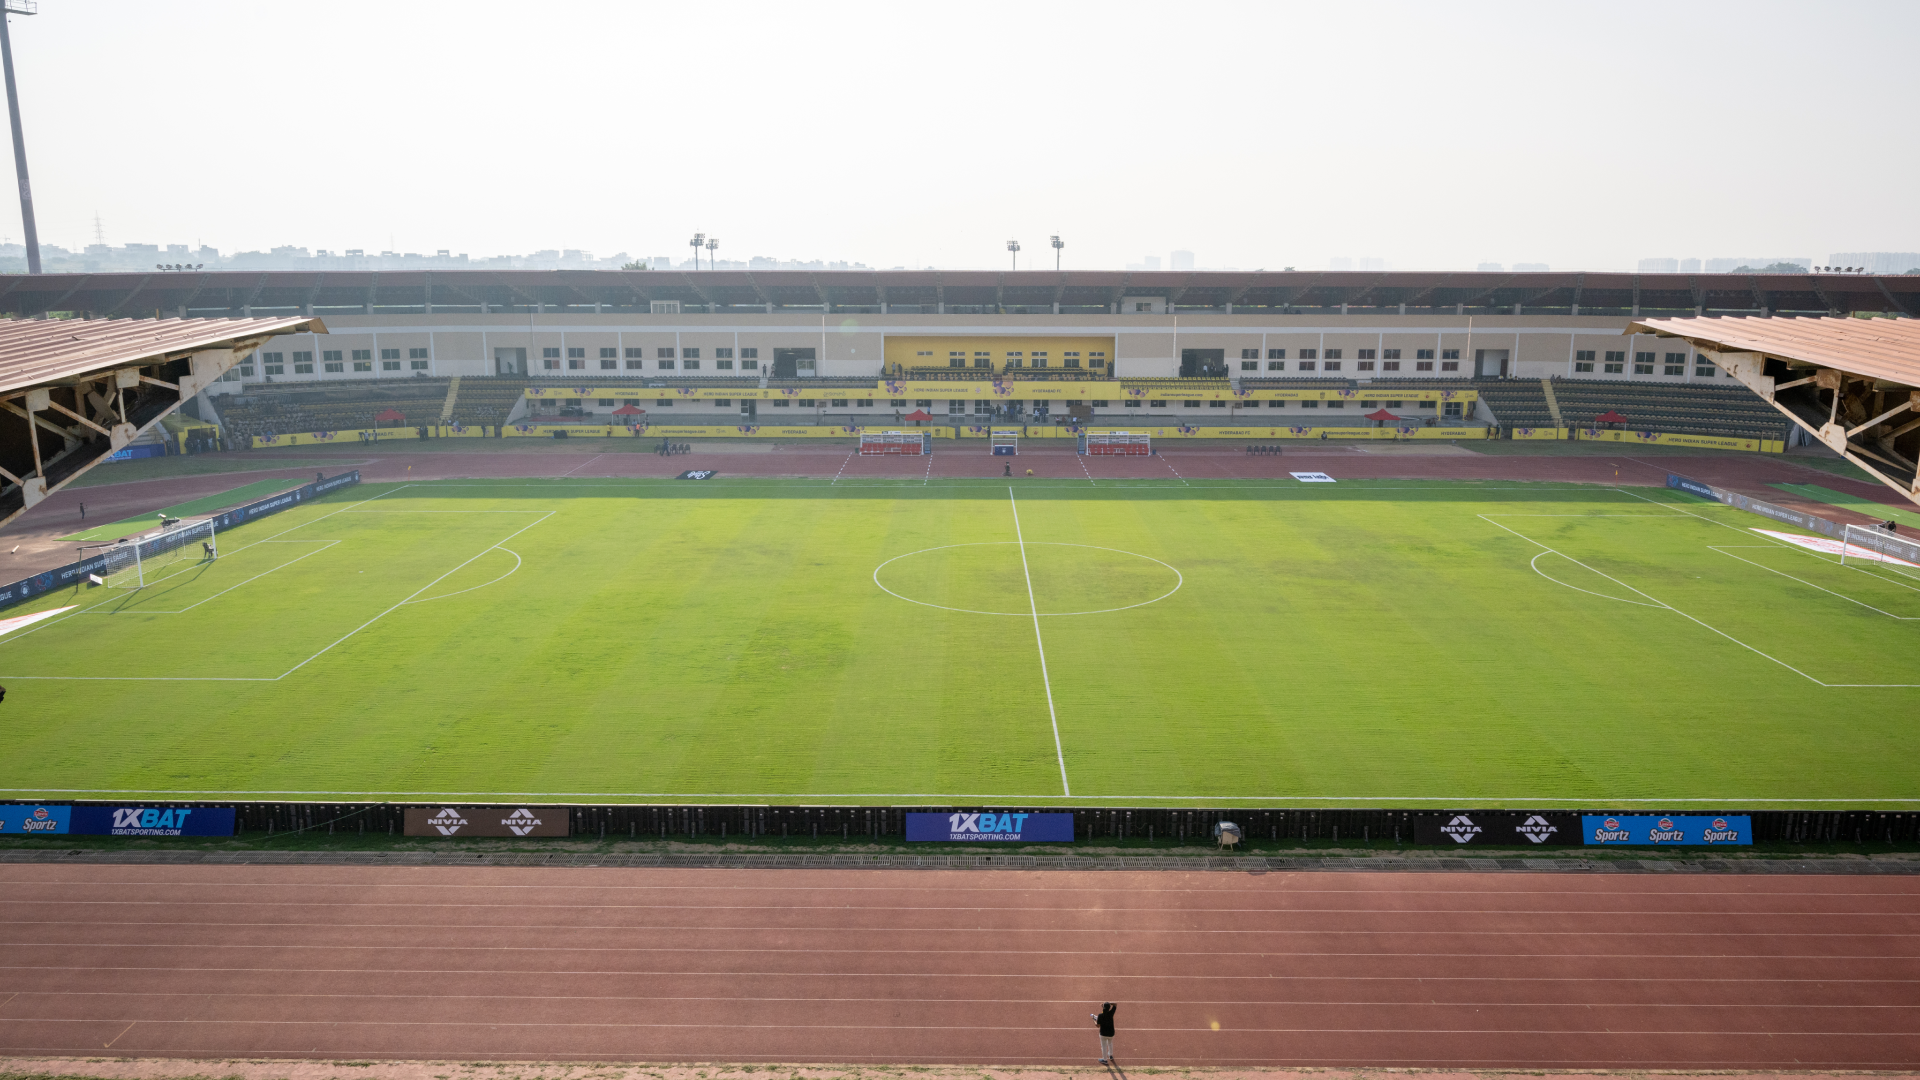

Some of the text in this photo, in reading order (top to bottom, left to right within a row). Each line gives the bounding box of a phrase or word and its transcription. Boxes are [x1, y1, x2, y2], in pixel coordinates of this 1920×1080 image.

[22, 818, 58, 832] Sportz
[112, 808, 192, 828] 1XBAT
[949, 813, 1028, 832] 1XBAT
[1594, 828, 1630, 843] Sportz
[1650, 828, 1684, 843] Sportz
[1704, 828, 1738, 843] Sportz
